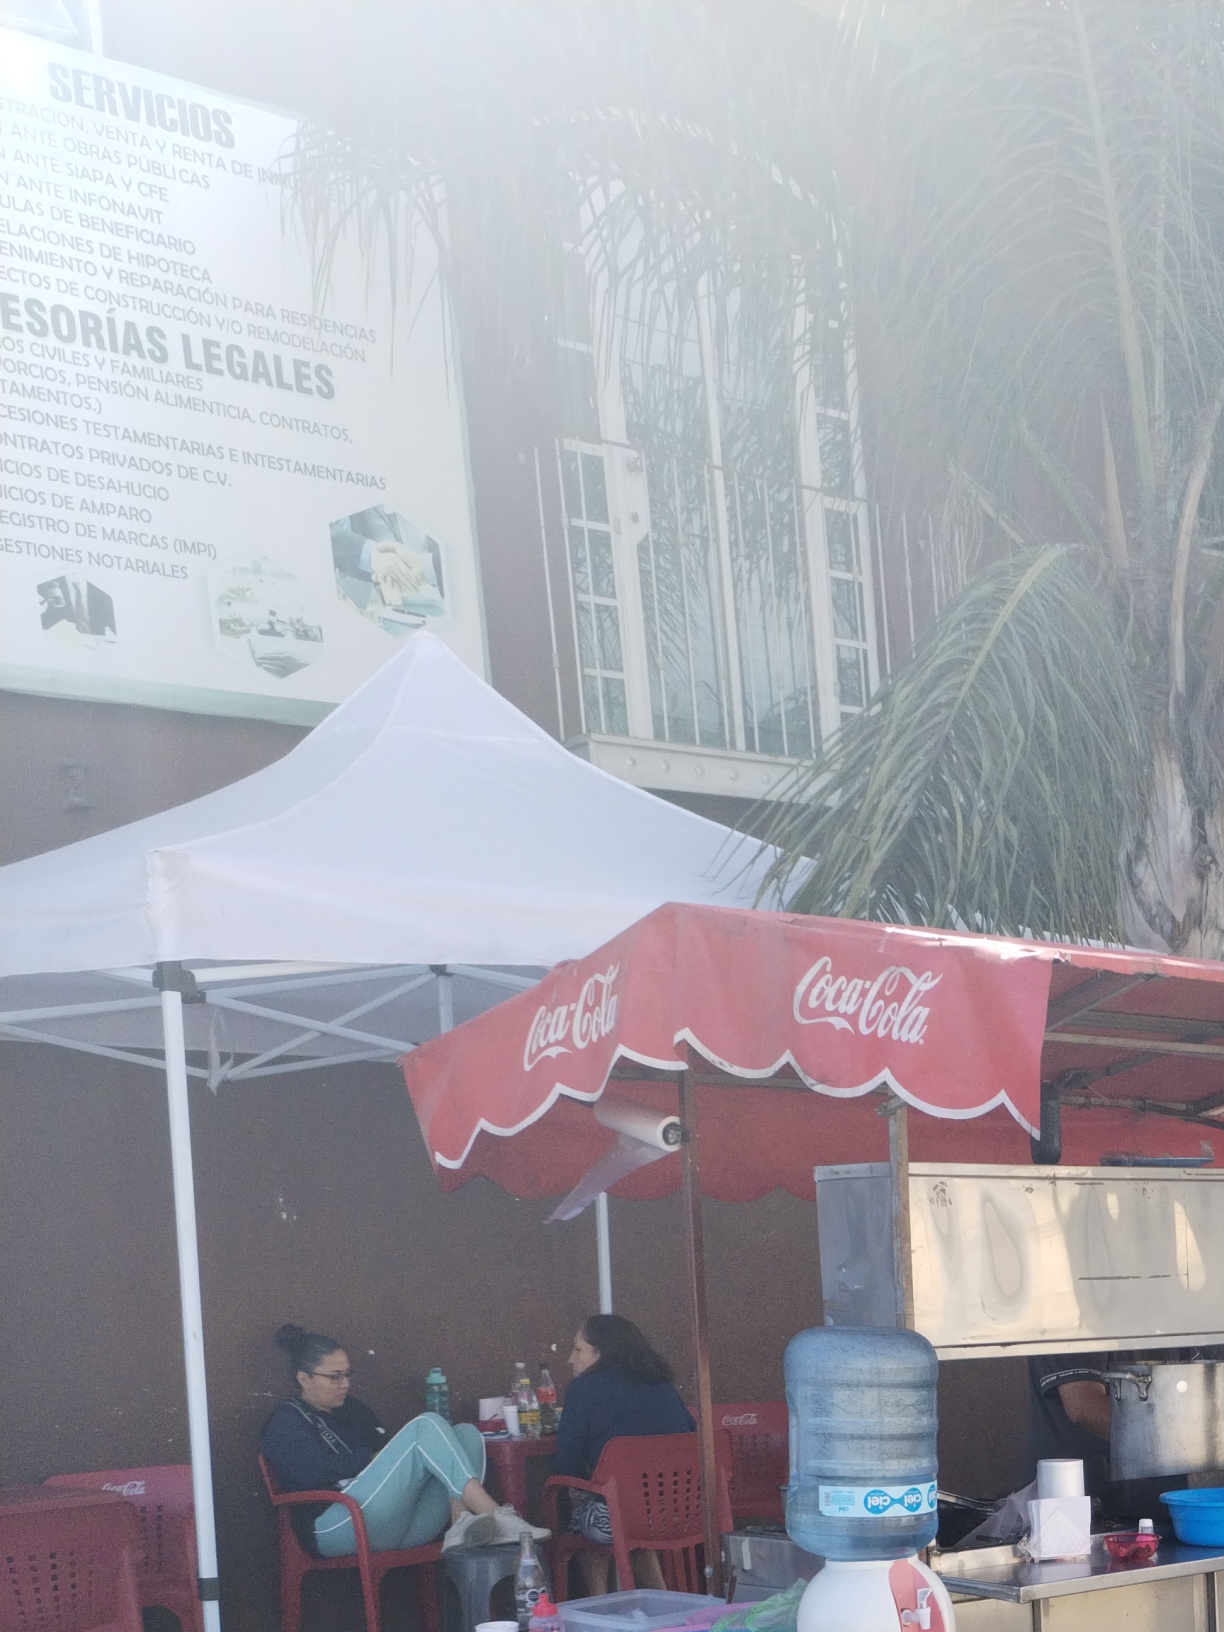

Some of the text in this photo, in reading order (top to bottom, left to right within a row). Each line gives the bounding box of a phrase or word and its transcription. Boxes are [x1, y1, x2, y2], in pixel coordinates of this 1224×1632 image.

[48, 62, 235, 149] SERVICIOS
[11, 123, 59, 149] ANTE
[63, 136, 122, 165] OBRAS
[93, 122, 152, 151] VENTA
[155, 138, 167, 154] Y
[172, 144, 227, 172] RENTA
[231, 159, 253, 179] DE
[13, 149, 60, 173] ANTE
[66, 161, 117, 188] SIAPA
[120, 176, 132, 192] Y
[137, 180, 170, 203] CFE
[16, 174, 64, 199] ANTE
[69, 187, 163, 225] INFONAVIT
[50, 205, 74, 225] DE
[78, 212, 196, 255] BENEFICIARIO
[99, 242, 123, 262] DE
[127, 249, 213, 285] HIPOTECA
[56, 277, 80, 298] DE
[83, 284, 211, 328] CONSTRUCCIÓN
[214, 315, 243, 335] Y/O
[247, 323, 366, 363] REMODELACIÓN
[101, 264, 113, 280] Y
[118, 268, 228, 309] REPARACIÓN
[232, 296, 276, 320] PARA
[280, 308, 376, 343] RESIDENCIAS
[0, 291, 335, 400] ESORÍAS LEGALES
[0, 335, 204, 392] OS CIVILES Y FAMILIARES
[0, 357, 353, 444] ORCIOS, PENSIÓN ALIMENTICIA, CONTRATOS,
[0, 431, 232, 488] NTRATOS PRIVADOS DE C.V.
[82, 418, 224, 460] TESTAMENTARIAS
[229, 447, 239, 463] E
[242, 450, 386, 491] INTESTAMENTARIAS
[47, 466, 70, 484] DE
[74, 471, 169, 501] DESAHUCIO
[51, 492, 75, 511] DE
[79, 497, 152, 524] AMPARO
[74, 521, 98, 539] DE
[101, 526, 169, 550] MARCAS
[173, 537, 217, 560] (IMPI)
[87, 551, 188, 580] NOTARIALES
[523, 962, 619, 1072] Coca-Cola
[793, 956, 943, 1044] Coca-Cola
[867, 1495, 891, 1510] ciel
[904, 1493, 922, 1508] ciel
